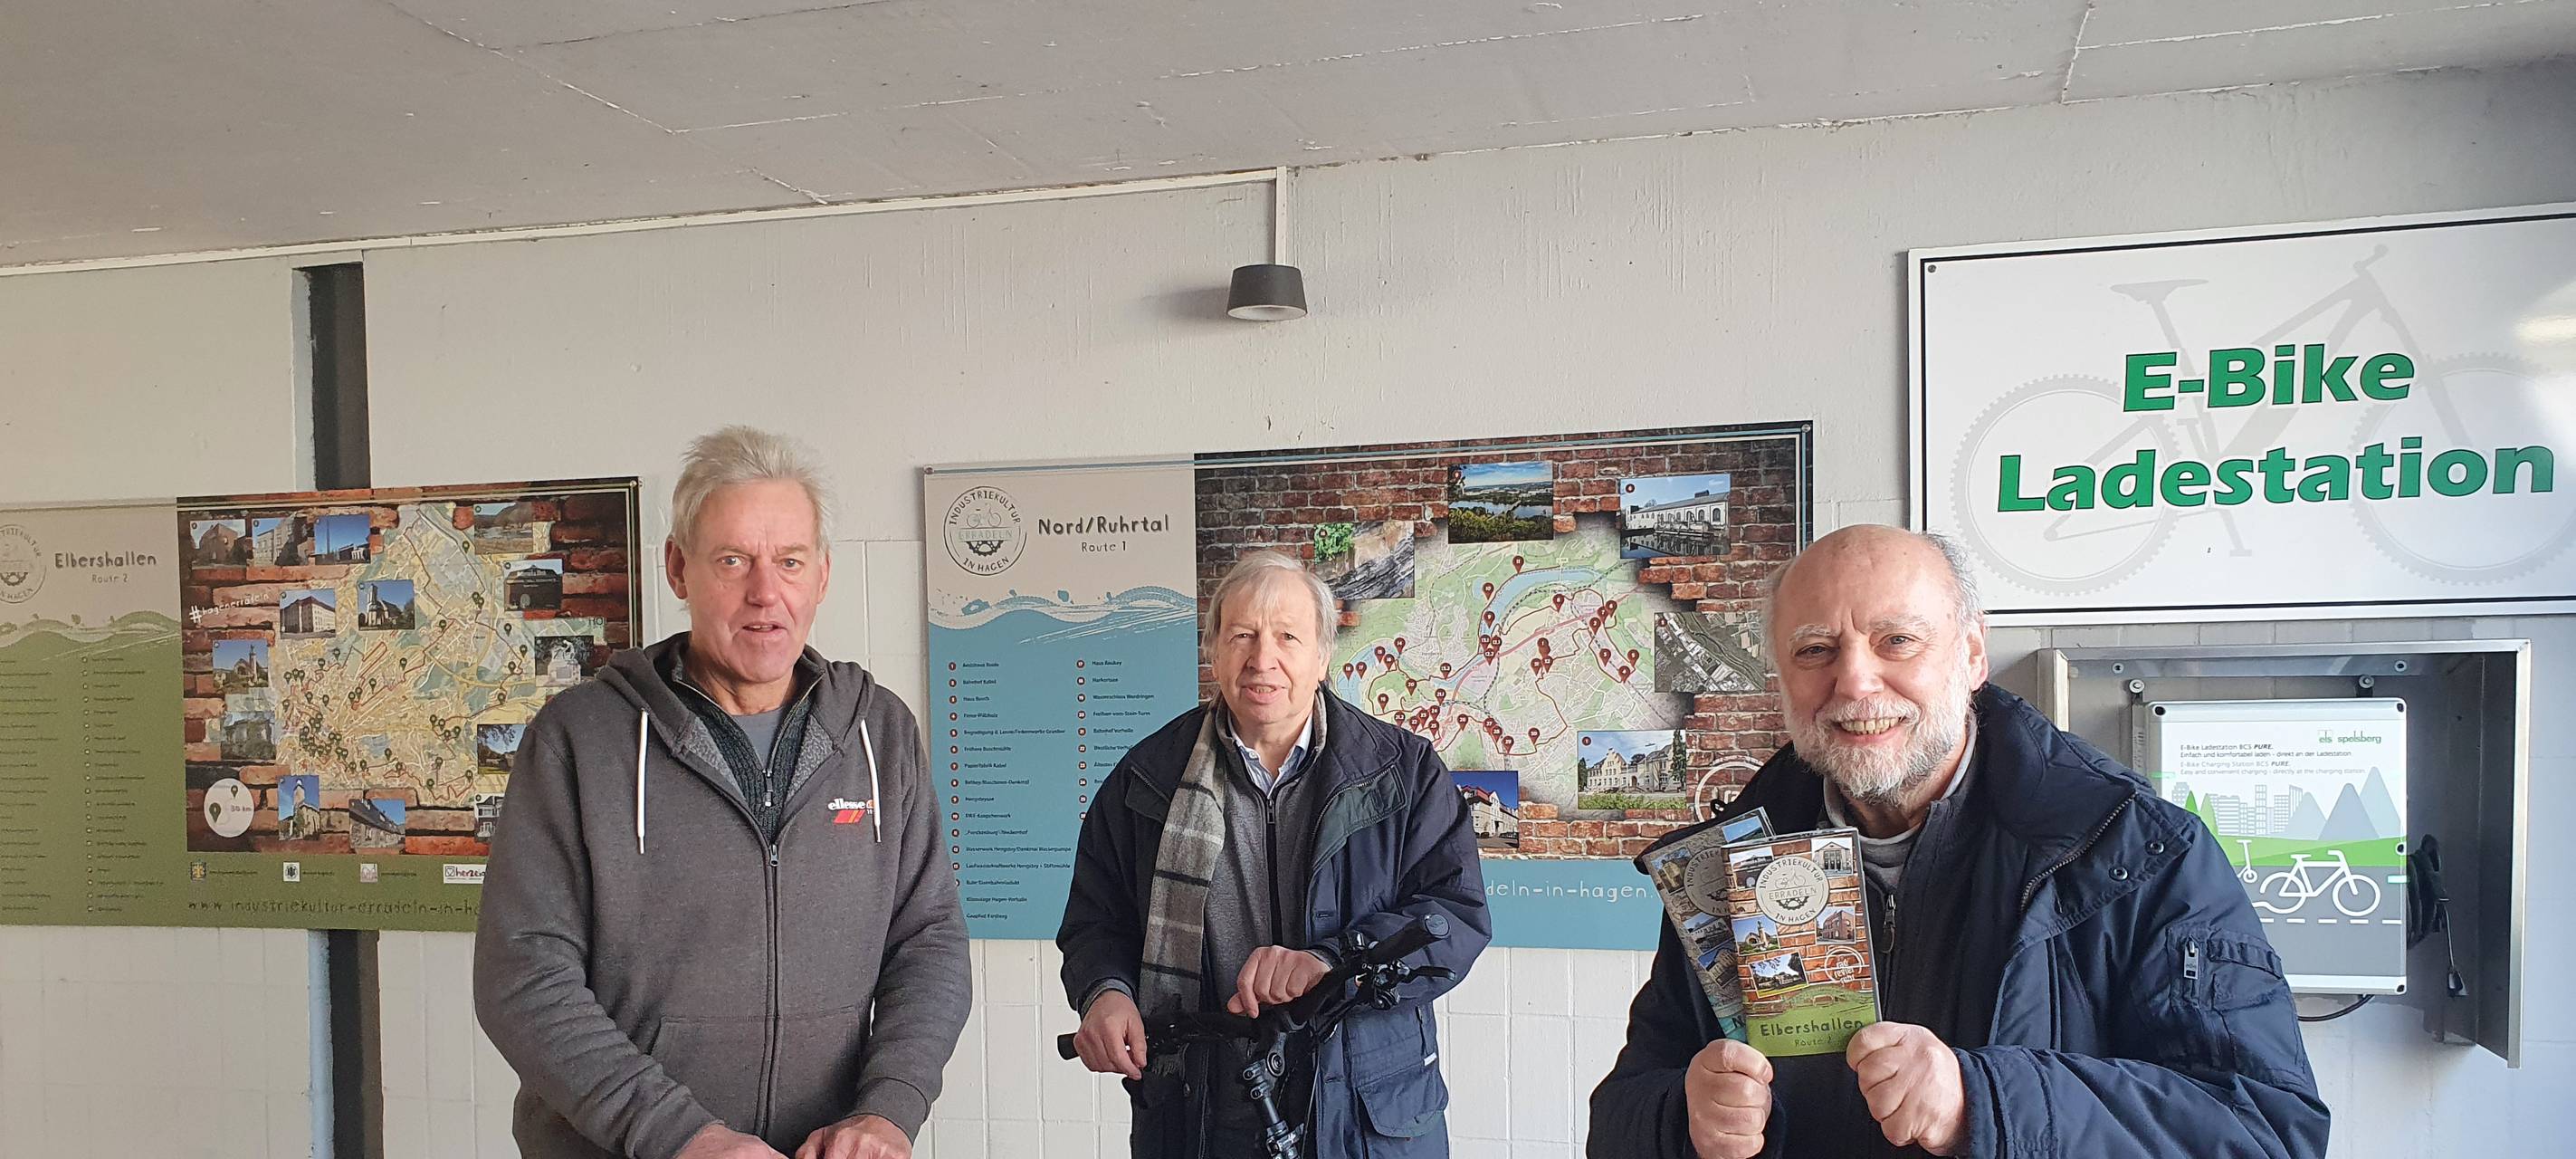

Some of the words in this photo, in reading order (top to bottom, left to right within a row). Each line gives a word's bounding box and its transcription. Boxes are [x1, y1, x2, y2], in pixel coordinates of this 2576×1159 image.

[2122, 342, 2415, 413] E-Bike
[1997, 436, 2555, 513] Ladestation
[949, 490, 1021, 525] INDUSTRIEKULTUR
[1037, 514, 1169, 535] Nord/Ruhrtal
[1081, 541, 1116, 553] Route
[1121, 541, 1127, 551] 1
[54, 551, 157, 569] Elbershallen
[962, 557, 976, 569] IN
[977, 556, 1010, 572] HAGEN
[91, 574, 119, 584] Route
[123, 573, 129, 583] 2
[2337, 730, 2382, 744] spelsberg
[827, 798, 866, 810] ellesse
[1759, 858, 1824, 889] INDUSTRIEKULTUR
[1769, 887, 1817, 900] ERRADELN
[1775, 913, 1786, 923] IN
[1788, 908, 1817, 923] HAGEN
[1760, 1017, 1865, 1037] Elbershallen
[1795, 1038, 1824, 1048] Route
